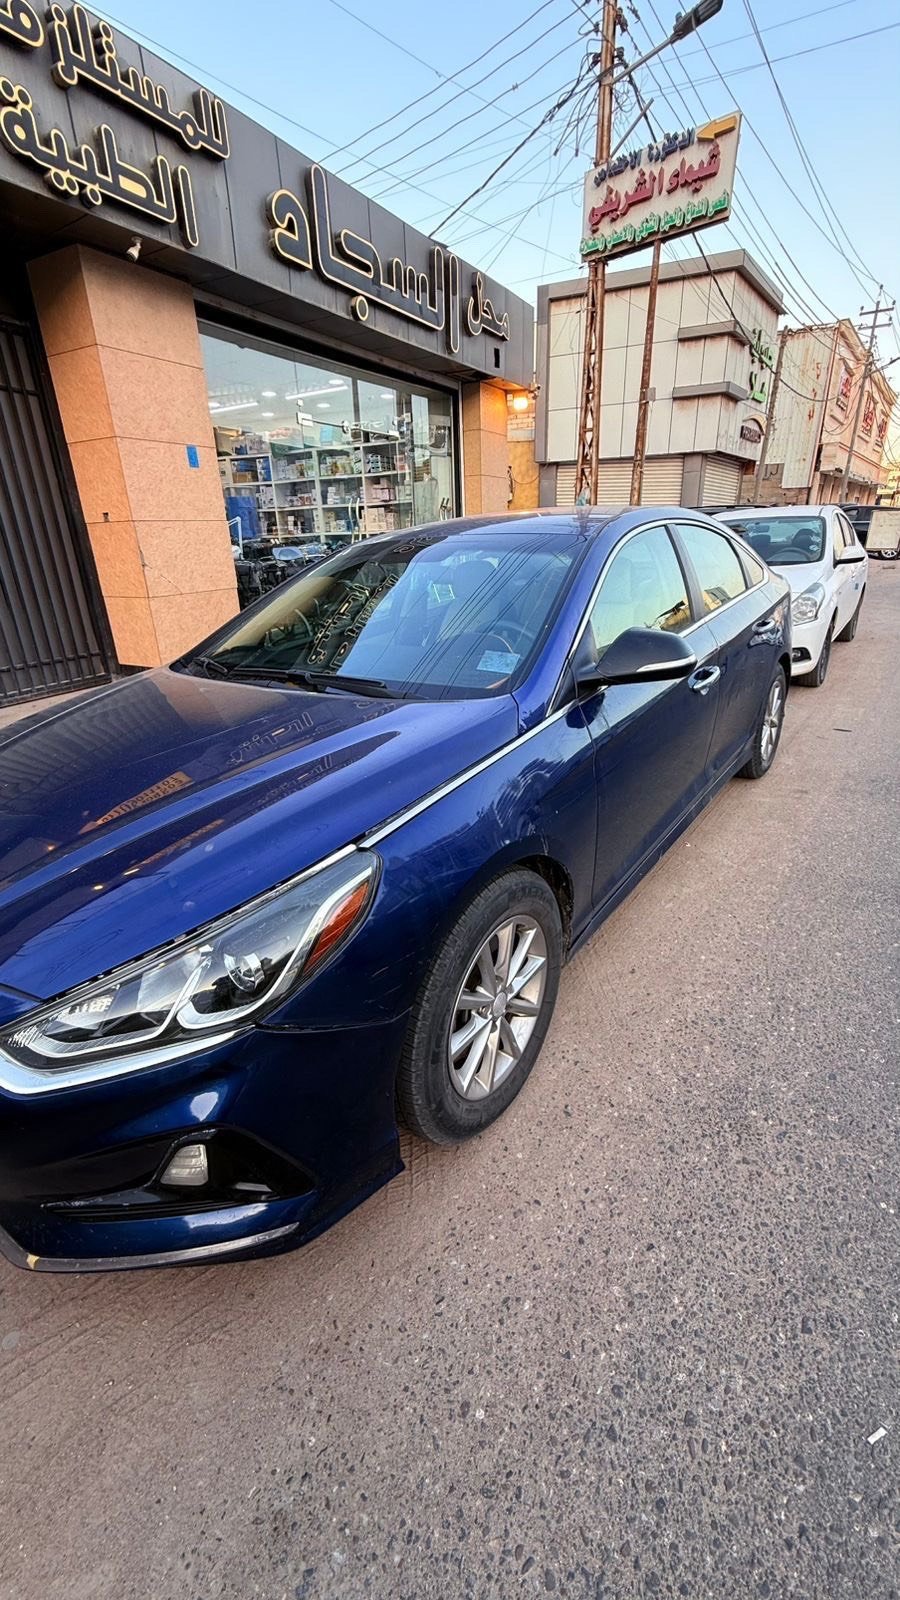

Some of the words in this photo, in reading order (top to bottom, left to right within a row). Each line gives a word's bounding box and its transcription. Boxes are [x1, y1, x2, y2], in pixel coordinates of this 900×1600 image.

[0, 0, 230, 159] للمستلزم
[0, 76, 199, 247] الطبية
[588, 166, 665, 233] الشريفي
[271, 163, 460, 353] السجاد
[467, 271, 511, 341] محل
